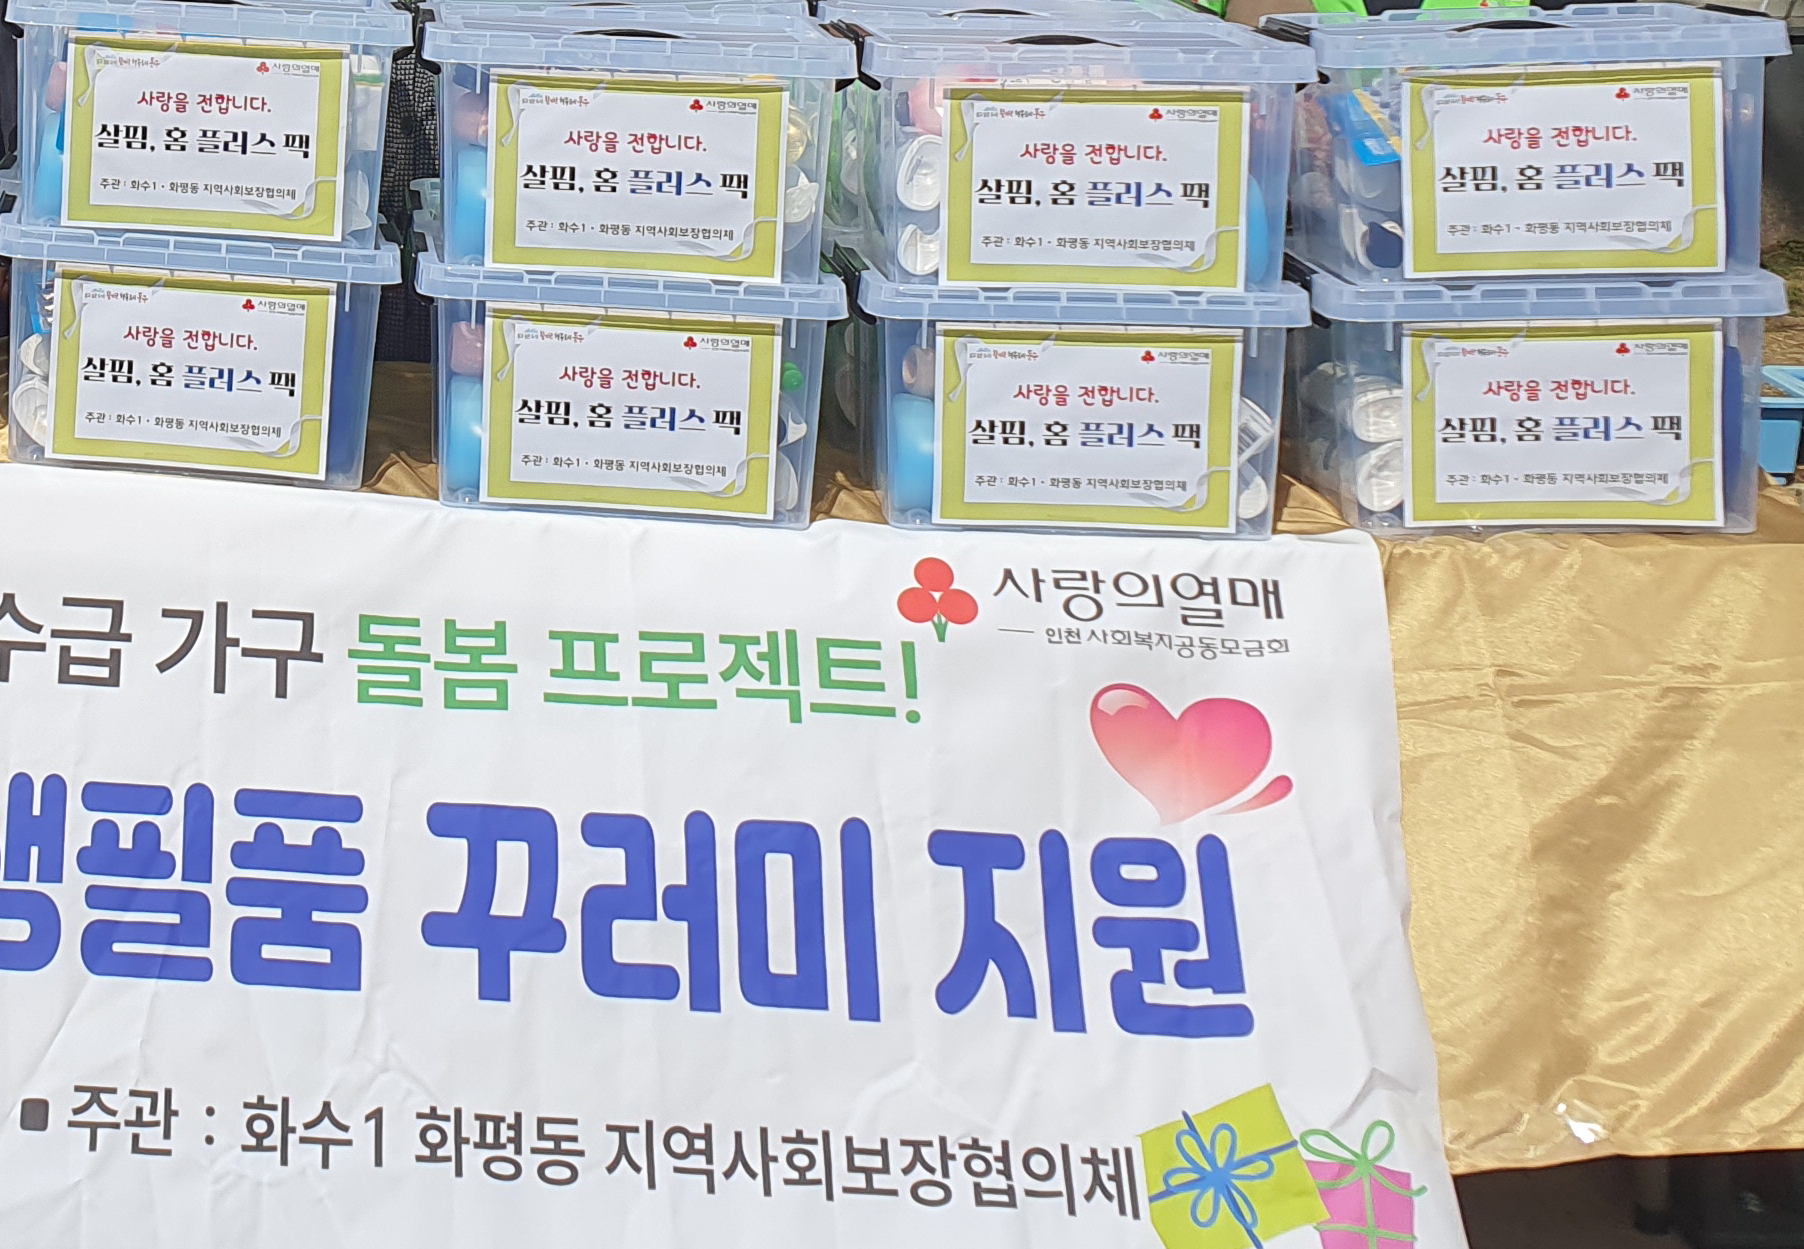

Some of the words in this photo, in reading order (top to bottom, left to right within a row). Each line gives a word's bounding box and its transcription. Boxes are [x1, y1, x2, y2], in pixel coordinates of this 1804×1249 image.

[136, 90, 189, 113] 사랑을
[196, 93, 272, 115] 전합니다.
[95, 123, 155, 153] 살핌,
[163, 128, 188, 152] 홈
[196, 130, 277, 156] 플러스
[282, 134, 310, 159] 팩
[564, 130, 619, 153] 사랑을
[627, 132, 707, 154] 전합니다.
[1483, 127, 1542, 150] 사랑을
[1550, 125, 1637, 148] 전합니다.
[1020, 143, 1077, 166] 사랑을
[1084, 143, 1167, 165] 전합니다.
[100, 178, 121, 189] 주관
[520, 164, 584, 194] 살핌,
[592, 168, 619, 193] 홈
[627, 170, 713, 196] 플러스
[719, 174, 748, 199] 팩
[1438, 165, 1508, 194] 살핌,
[1515, 165, 1545, 191] 홈
[1553, 162, 1646, 190] 플러스
[1652, 161, 1684, 187] 팩
[975, 179, 1041, 208] 살핌,
[1049, 180, 1077, 206] 홈
[1085, 181, 1174, 207] 플러스
[1179, 182, 1210, 208] 팩
[526, 220, 548, 231] 주관
[981, 236, 1004, 247] 주관
[123, 325, 175, 349] 사랑을
[182, 329, 258, 351] 전합니다.
[81, 356, 141, 388] 살핌,
[148, 363, 174, 388] 홈
[181, 365, 263, 393] 플러스
[268, 372, 296, 397] 팩
[559, 365, 614, 389] 사랑을
[621, 368, 701, 390] 전합니다.
[1483, 380, 1542, 402] 사랑을
[1550, 378, 1636, 401] 전합니다.
[1013, 384, 1069, 406] 사랑을
[1077, 384, 1159, 407] 전합니다.
[515, 399, 579, 429] 살핌,
[586, 403, 614, 429] 홈
[621, 406, 706, 432] 플러스
[712, 410, 741, 436] 팩
[1438, 417, 1507, 445] 살핌,
[1514, 417, 1543, 442] 홈
[1551, 416, 1644, 442] 플러스
[1650, 415, 1682, 441] 팩
[968, 419, 1034, 448] 살핌,
[1042, 421, 1070, 447] 홈
[1078, 422, 1165, 448] 플러스
[1171, 424, 1201, 449] 팩
[993, 567, 1285, 628] 사랑의열매
[1045, 627, 1082, 645] 인천
[1086, 628, 1290, 661] 사회복지공동모금회
[156, 601, 323, 699] 가구
[348, 614, 518, 711] 돌봄
[544, 627, 922, 725] 프로젝트!
[421, 802, 881, 1022] 꾸러미
[927, 829, 1254, 1039] 지원
[67, 1085, 179, 1156] 주관
[241, 1095, 383, 1169] 화수1
[415, 1106, 585, 1186] 화평동
[604, 1119, 1142, 1220] 지역사회보장협의체
